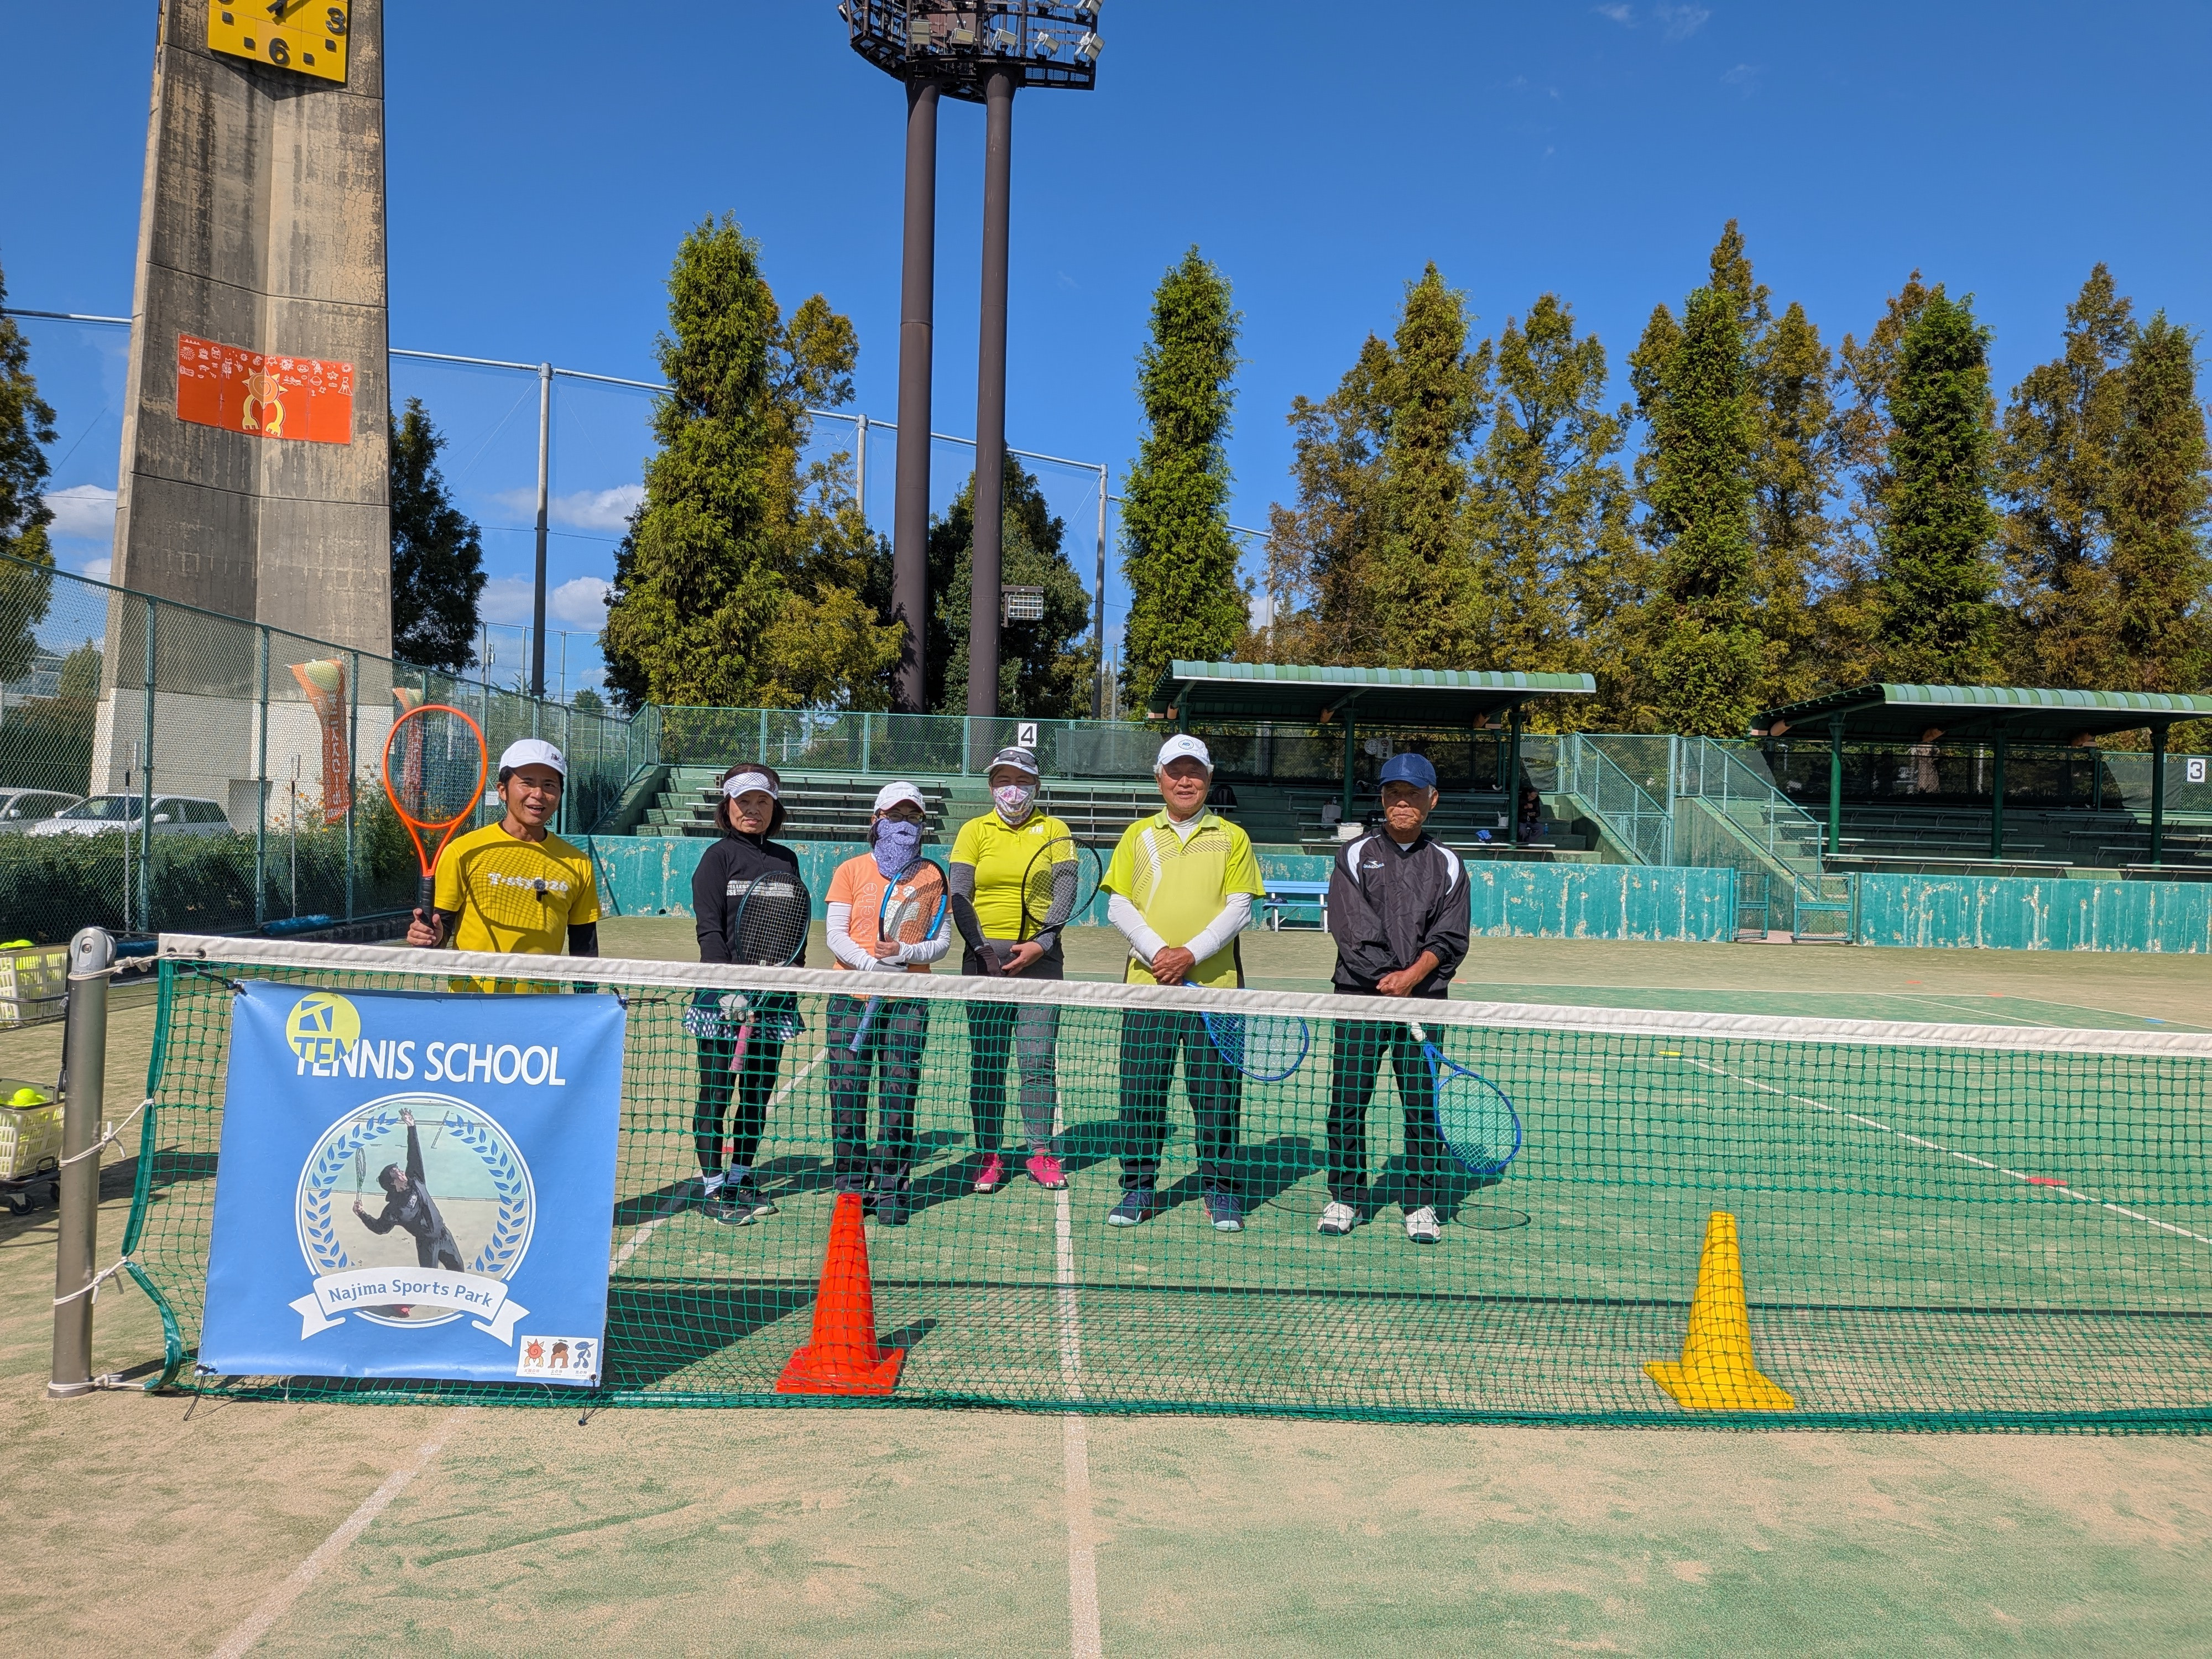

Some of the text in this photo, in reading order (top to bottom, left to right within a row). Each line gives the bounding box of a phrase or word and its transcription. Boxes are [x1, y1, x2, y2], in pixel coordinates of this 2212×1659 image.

[326, 7, 346, 33] 3
[269, 38, 290, 64] 6
[1021, 726, 1034, 744] 4
[2190, 761, 2203, 779] 3
[487, 873, 568, 891] T-sty26
[294, 1036, 566, 1086] TENNIS SCHOOL
[327, 1279, 493, 1307] Najima Sports Park
